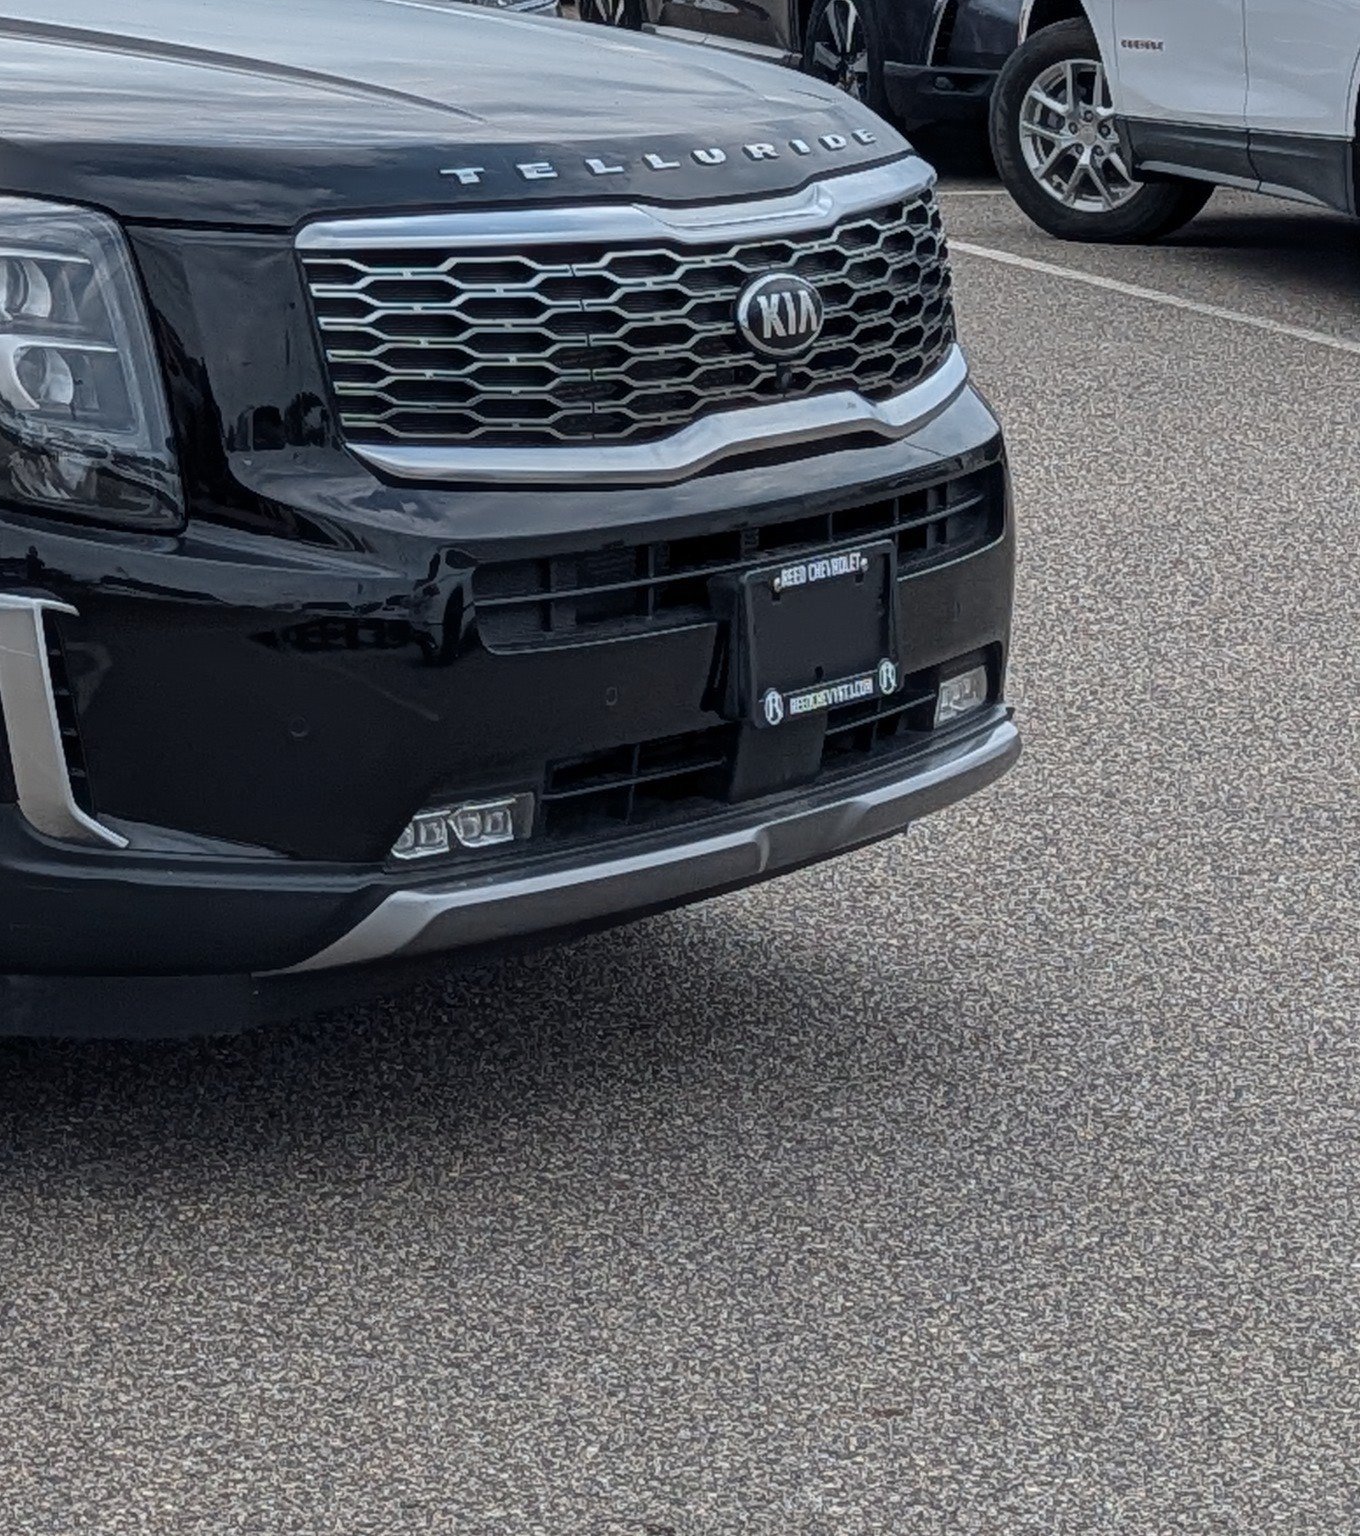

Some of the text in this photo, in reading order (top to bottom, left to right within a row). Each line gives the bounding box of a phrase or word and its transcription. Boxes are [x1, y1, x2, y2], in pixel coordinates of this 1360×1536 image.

[440, 128, 877, 185] TELLURIDE
[756, 290, 818, 339] KIA
[808, 553, 861, 582] CHEVROLET
